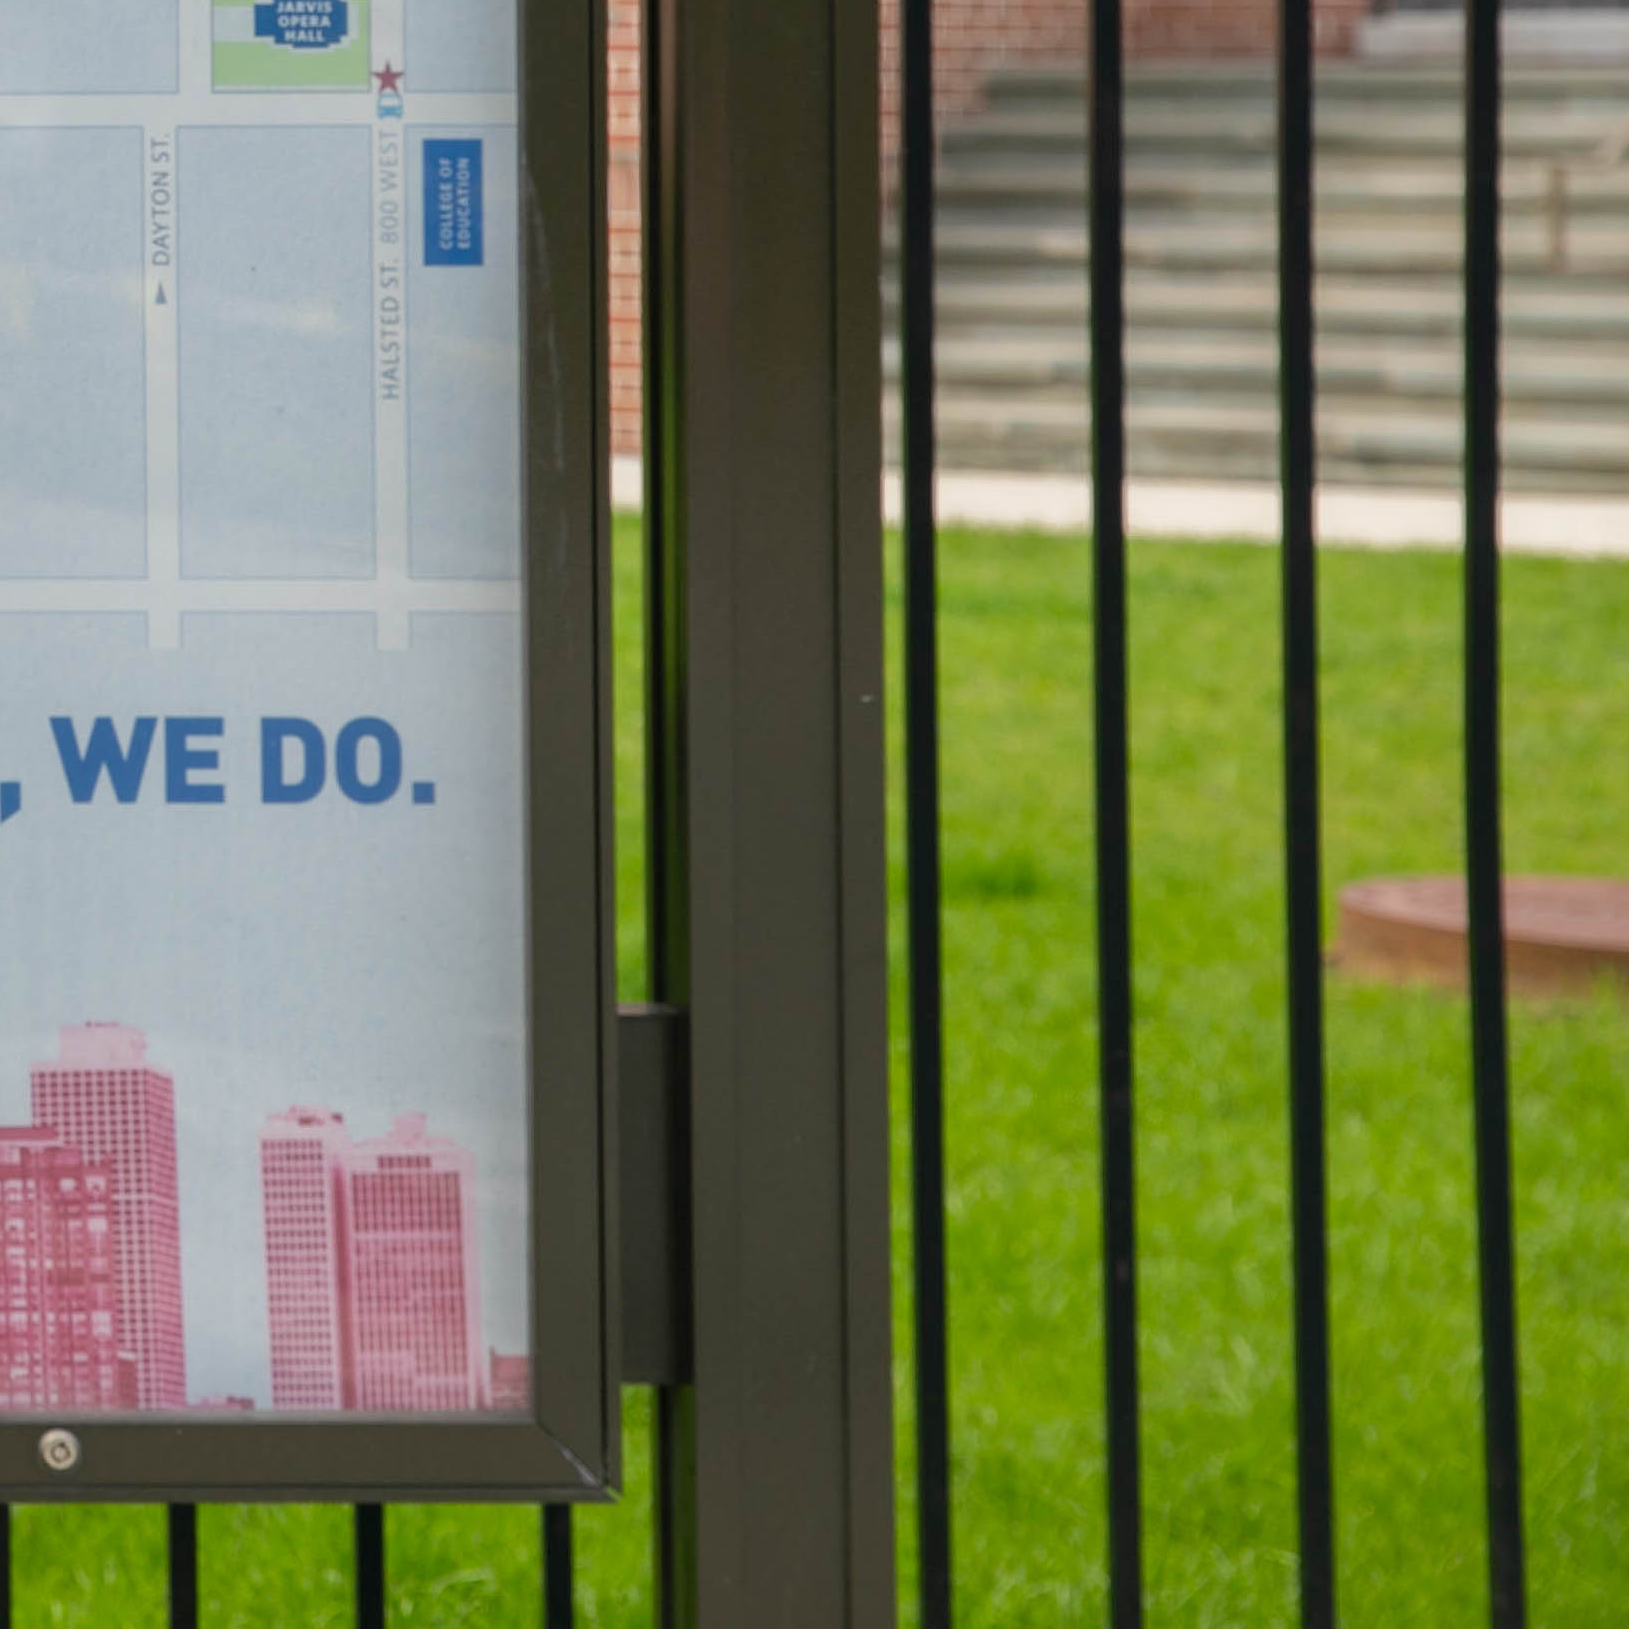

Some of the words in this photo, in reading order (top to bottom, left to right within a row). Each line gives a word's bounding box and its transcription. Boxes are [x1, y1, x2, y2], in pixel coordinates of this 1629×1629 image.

[276, 0, 332, 13] JARVIS
[277, 15, 331, 28] OPERA
[284, 29, 324, 42] HALL
[151, 132, 170, 163] ST.
[379, 128, 399, 197] WEST
[439, 158, 452, 178] OF
[151, 170, 170, 267] DAYTON
[379, 203, 399, 244] 800
[439, 180, 452, 250] COLLEGE
[456, 158, 471, 250] EDUCATION
[380, 294, 400, 400] HALSTED
[48, 715, 226, 804] WE
[260, 715, 436, 805] DO.
